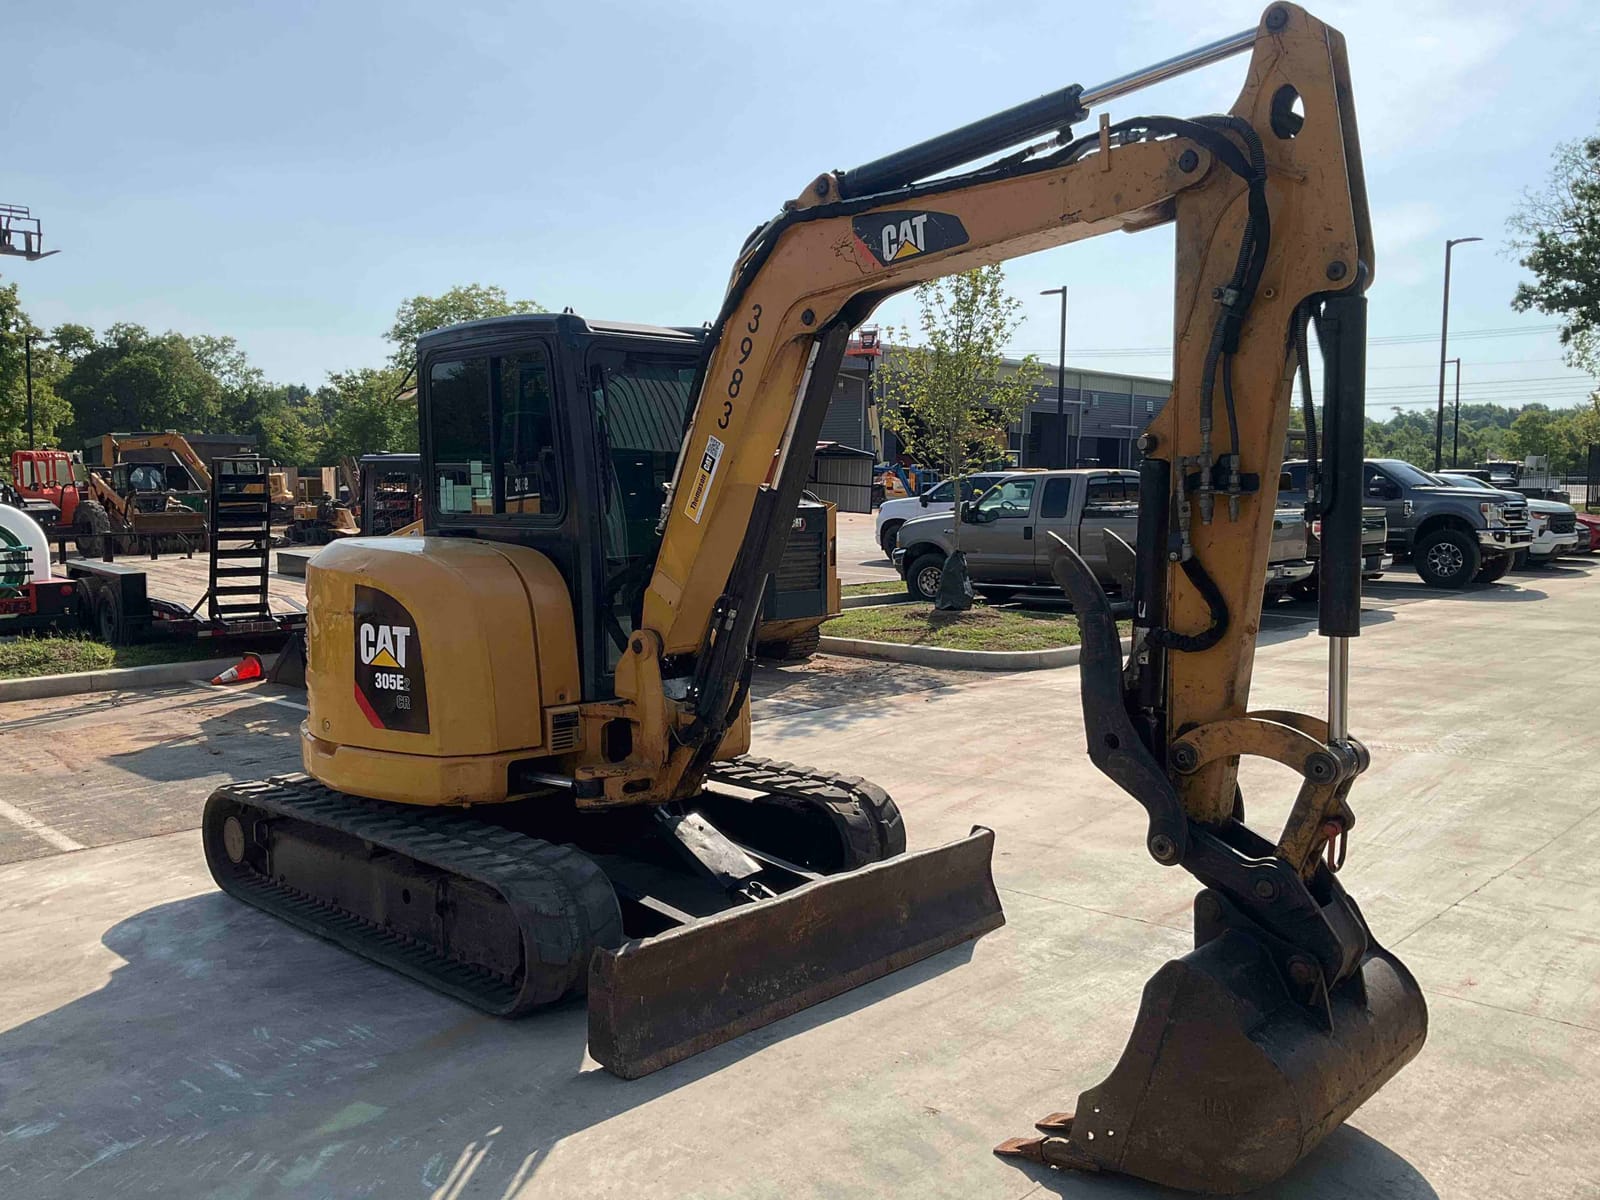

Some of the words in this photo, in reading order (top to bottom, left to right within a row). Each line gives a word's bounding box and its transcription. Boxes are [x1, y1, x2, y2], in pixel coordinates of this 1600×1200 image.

[882, 213, 928, 262] CAT
[717, 303, 763, 430] 3983
[690, 473, 707, 510] Thompson
[703, 455, 713, 472] CAT
[360, 622, 411, 669] CAT
[396, 694, 411, 710] CR
